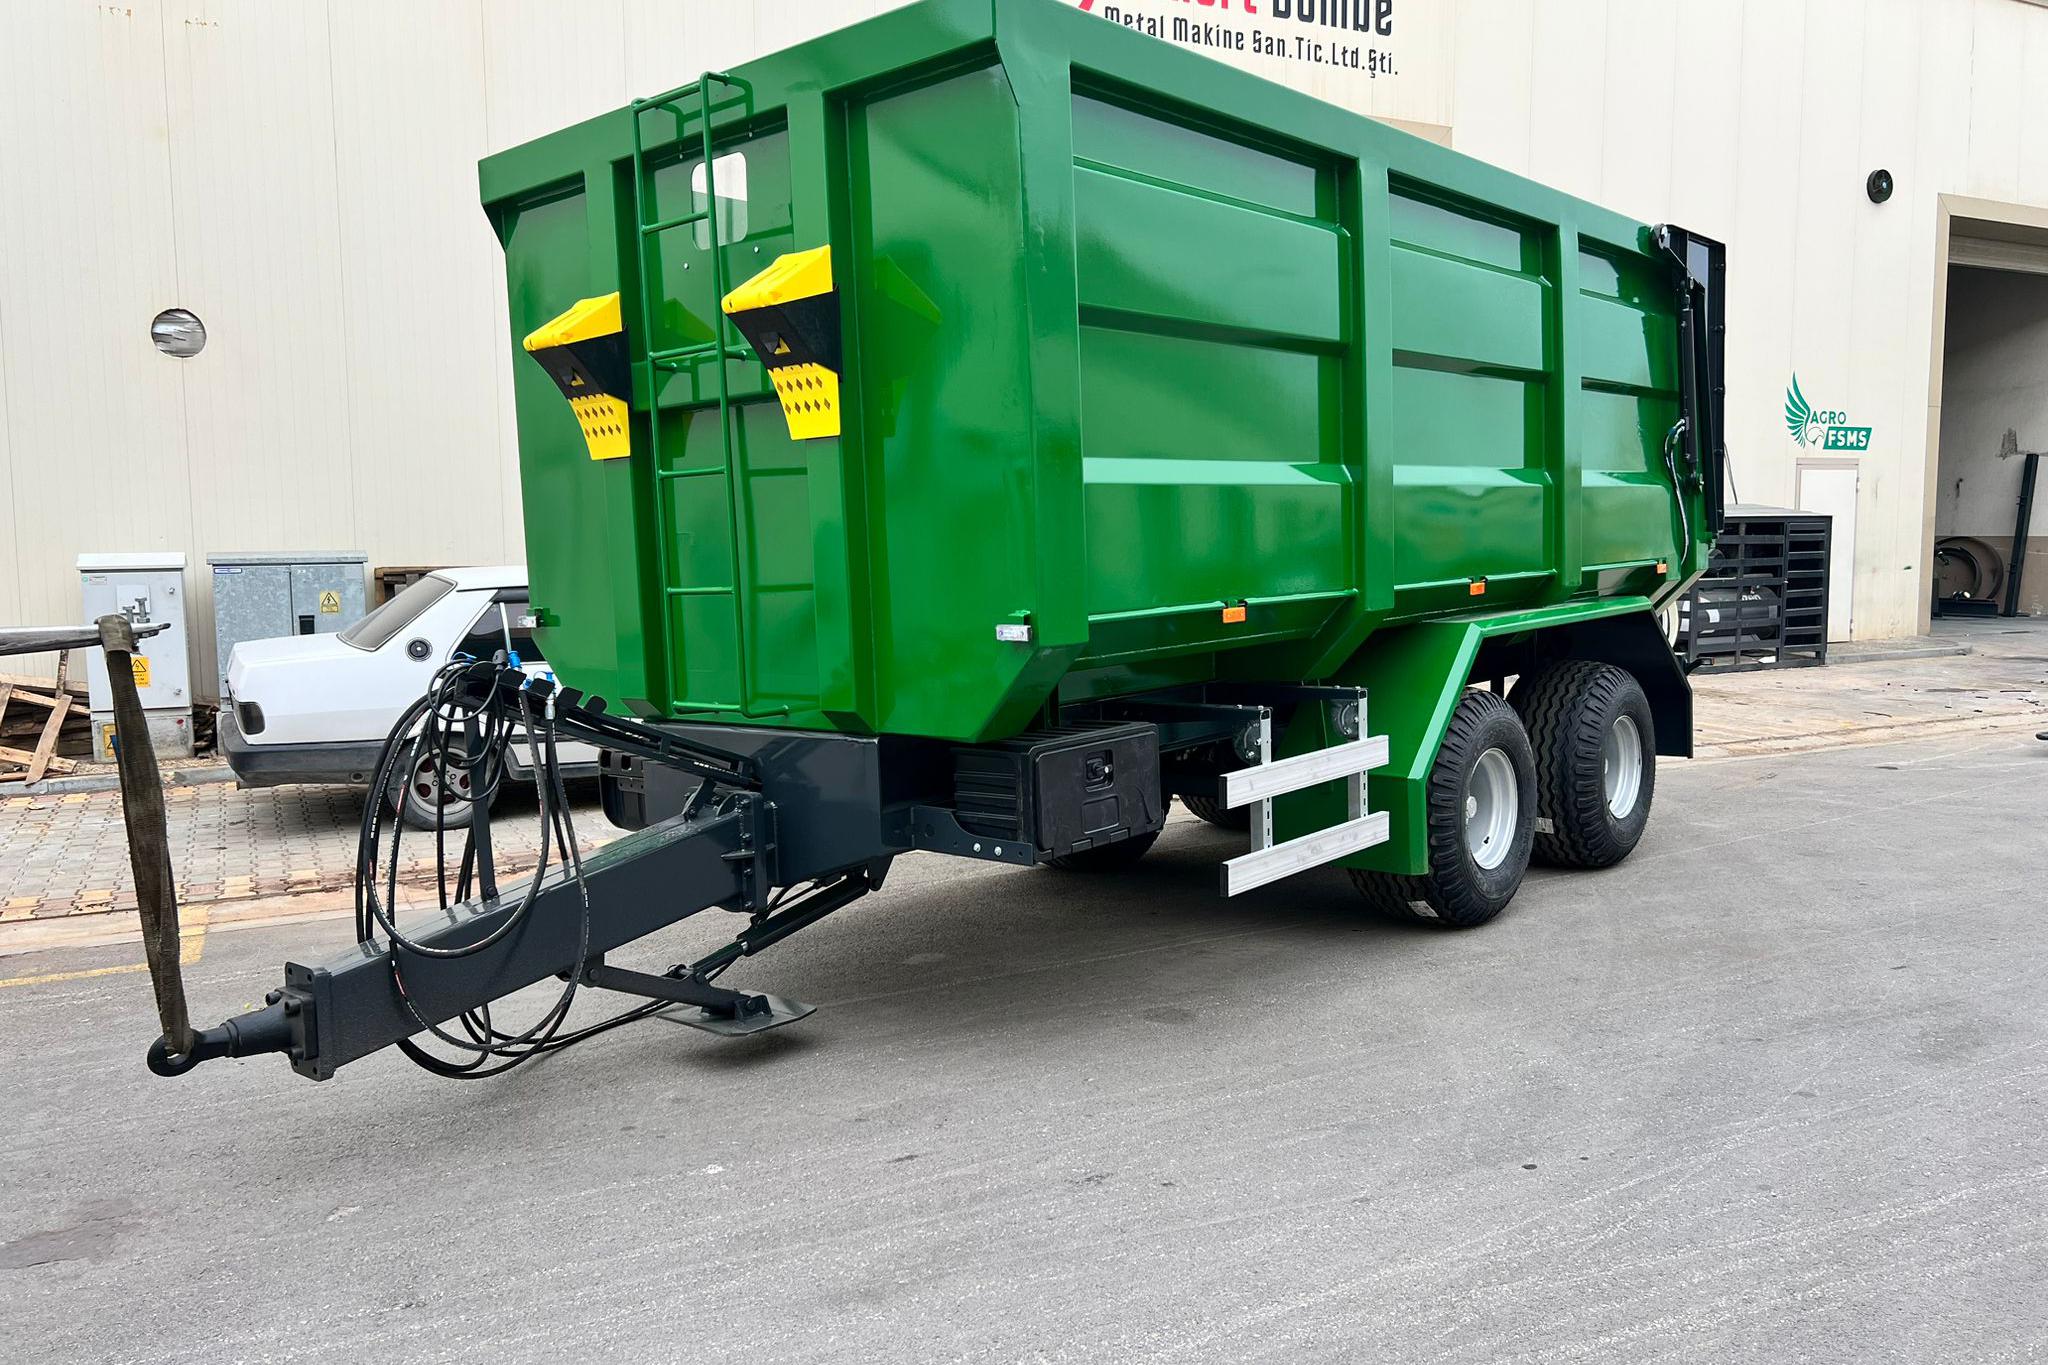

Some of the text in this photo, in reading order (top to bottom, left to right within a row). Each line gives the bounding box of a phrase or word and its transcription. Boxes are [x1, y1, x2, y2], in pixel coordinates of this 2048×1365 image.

[1173, 17, 1244, 51] Makine
[1810, 411, 1847, 425] AGRO
[1828, 430, 1867, 447] FSMS
